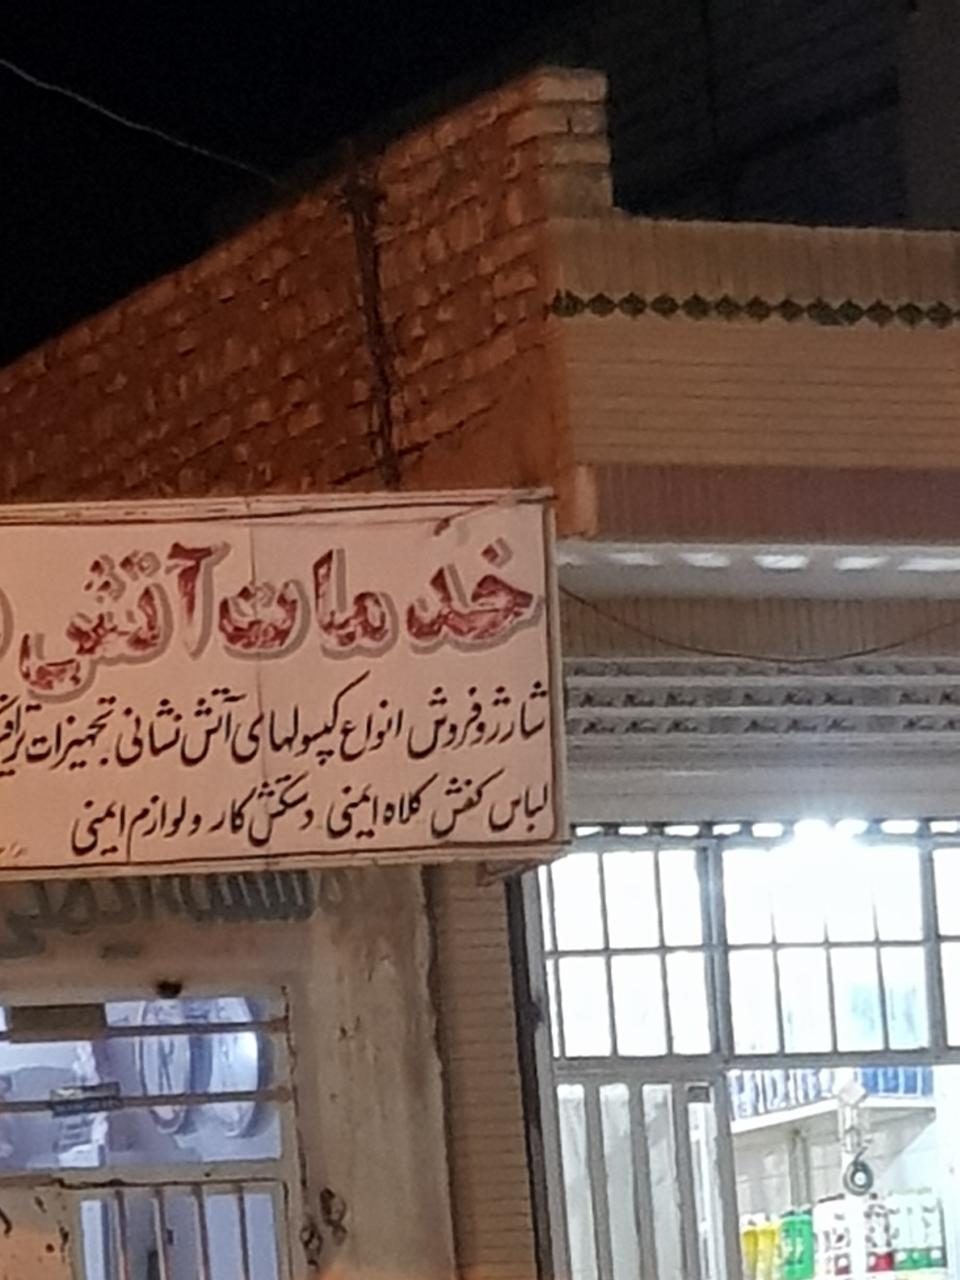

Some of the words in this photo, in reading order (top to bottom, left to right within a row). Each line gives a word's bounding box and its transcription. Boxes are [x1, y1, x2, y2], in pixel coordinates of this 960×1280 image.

[19, 541, 231, 701] آتش
[217, 536, 540, 658] خدمات
[25, 696, 117, 770] تجهیزات
[116, 698, 181, 767] نشانی
[181, 687, 247, 767] آتش
[340, 699, 403, 762] انواع
[407, 686, 482, 760] فروش
[484, 681, 548, 744] شارژ
[71, 799, 126, 857] ایمنی
[125, 795, 187, 863] لوازم
[188, 814, 202, 836] و
[207, 786, 257, 834] کار
[248, 771, 314, 847] دستکش
[326, 784, 378, 839] ایمنی
[383, 773, 439, 826] کلاه
[431, 768, 505, 839] کفش
[488, 783, 548, 833] لباس
